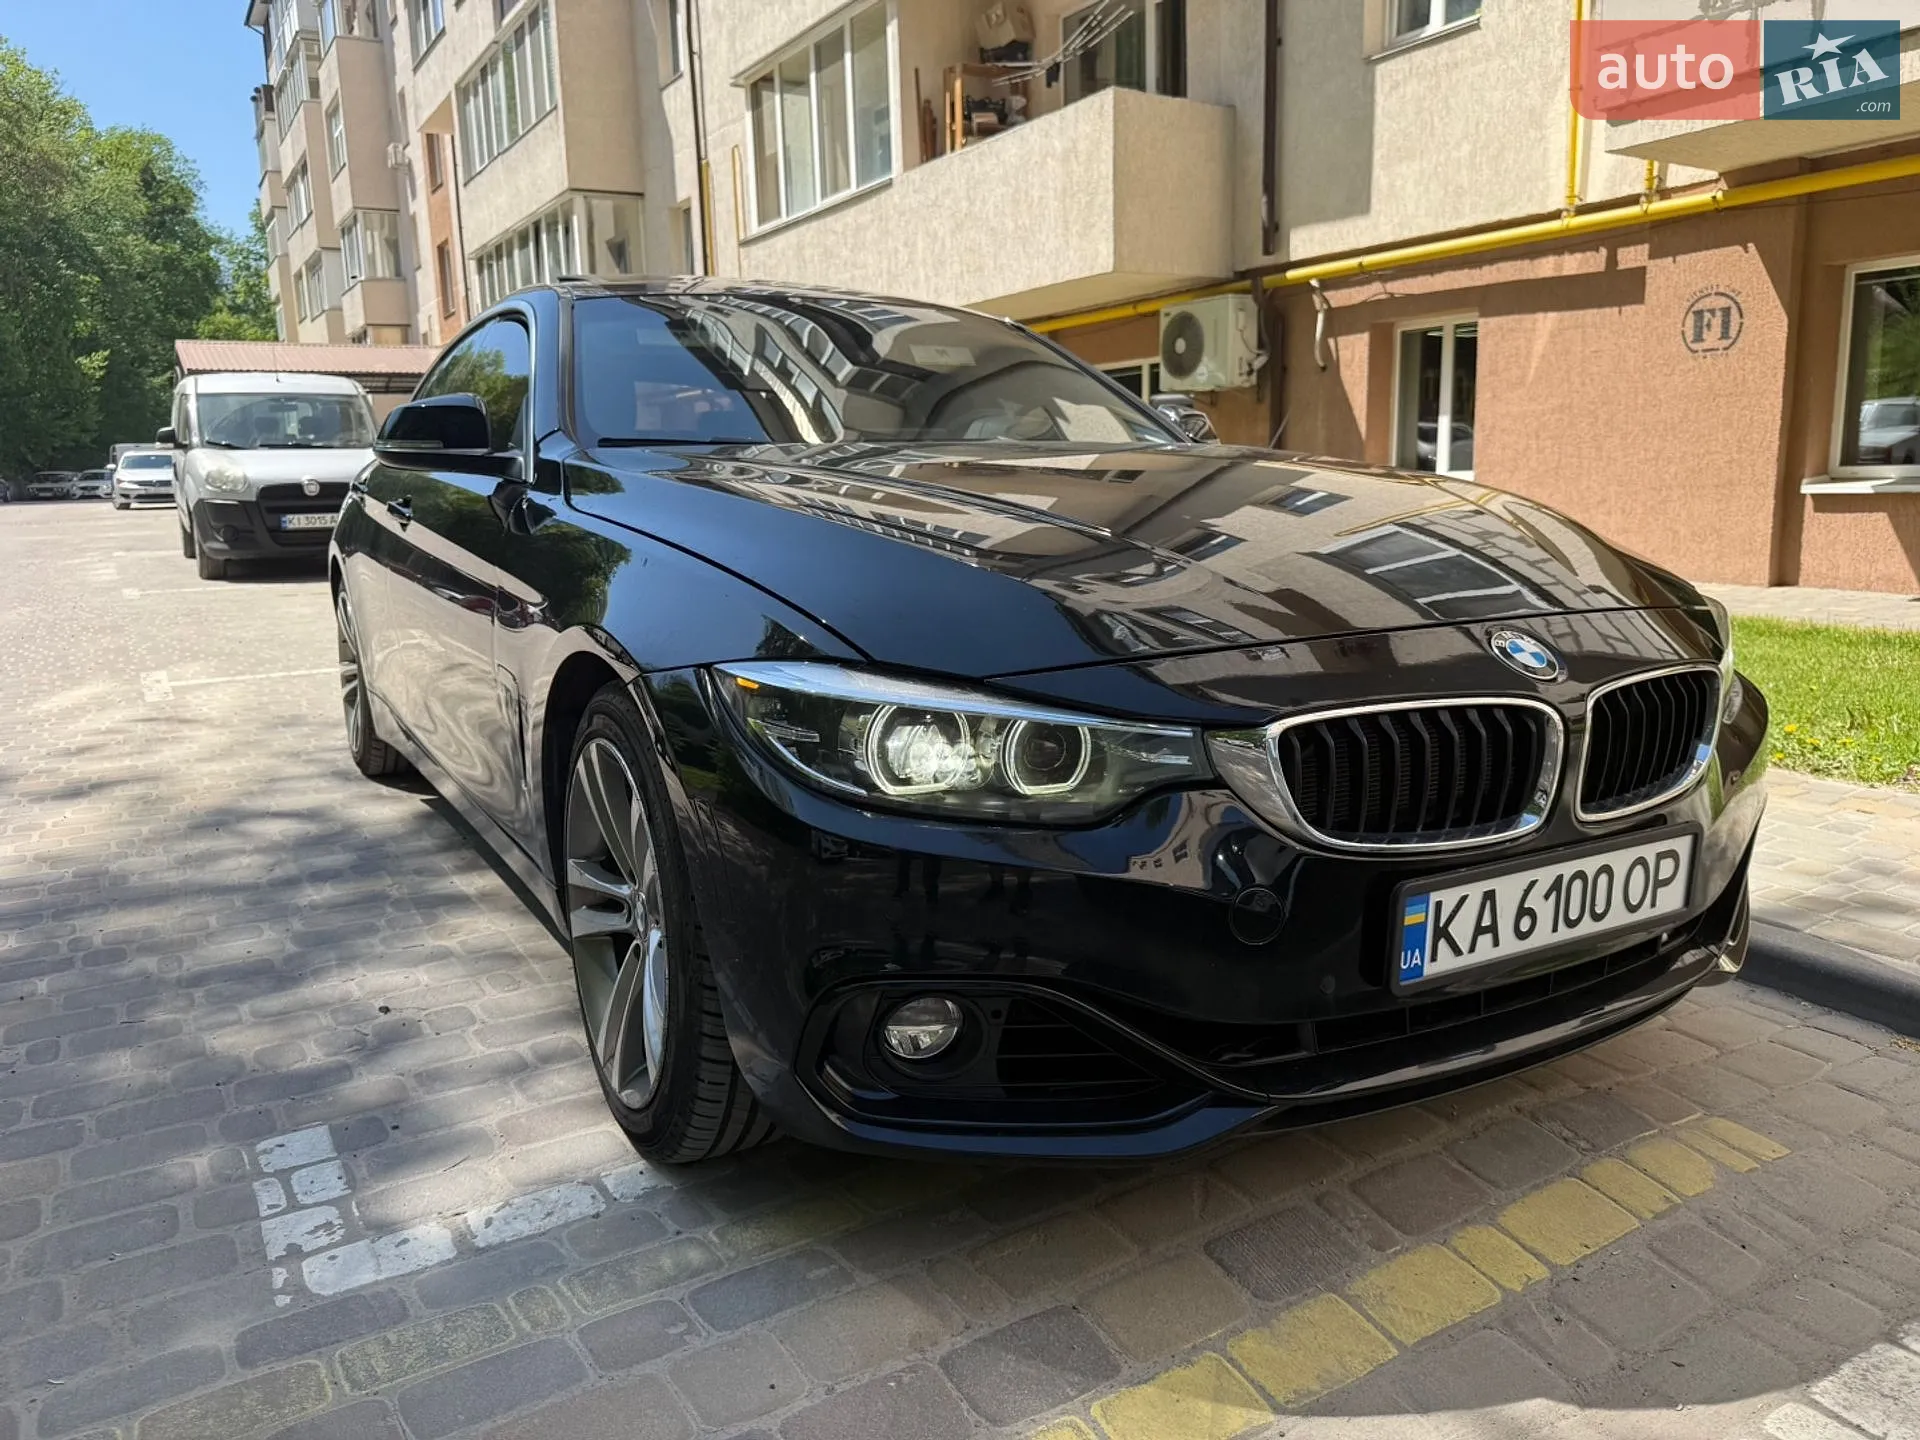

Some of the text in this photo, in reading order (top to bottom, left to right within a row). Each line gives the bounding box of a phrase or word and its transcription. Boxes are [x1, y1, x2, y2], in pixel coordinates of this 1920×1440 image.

[1690, 307, 1732, 343] F1
[1429, 848, 1681, 963] KA 6100 OP
[1400, 948, 1422, 969] UA
